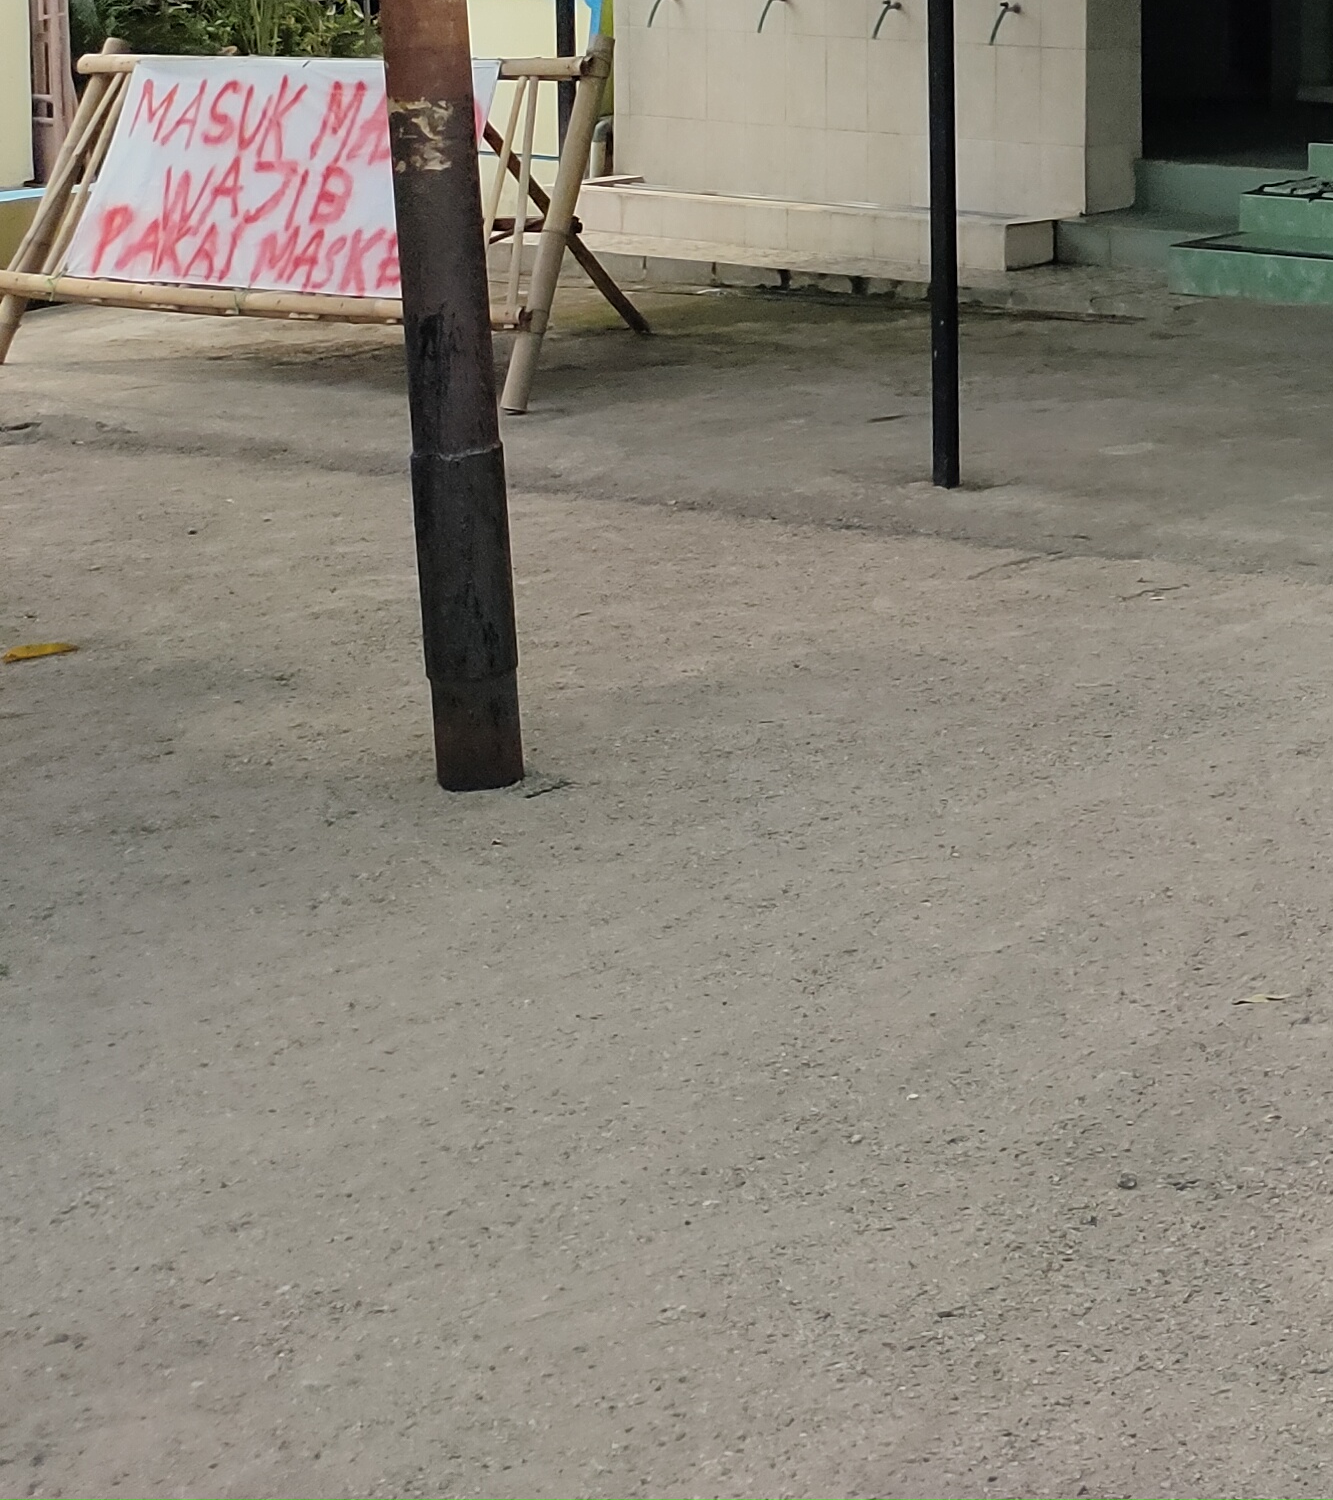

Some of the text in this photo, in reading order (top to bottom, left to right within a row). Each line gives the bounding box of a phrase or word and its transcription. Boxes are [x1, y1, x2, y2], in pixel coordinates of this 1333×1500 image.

[128, 75, 308, 160] MASUK
[161, 156, 353, 235] WAJIB
[91, 204, 400, 296] PAKAI MASKE
